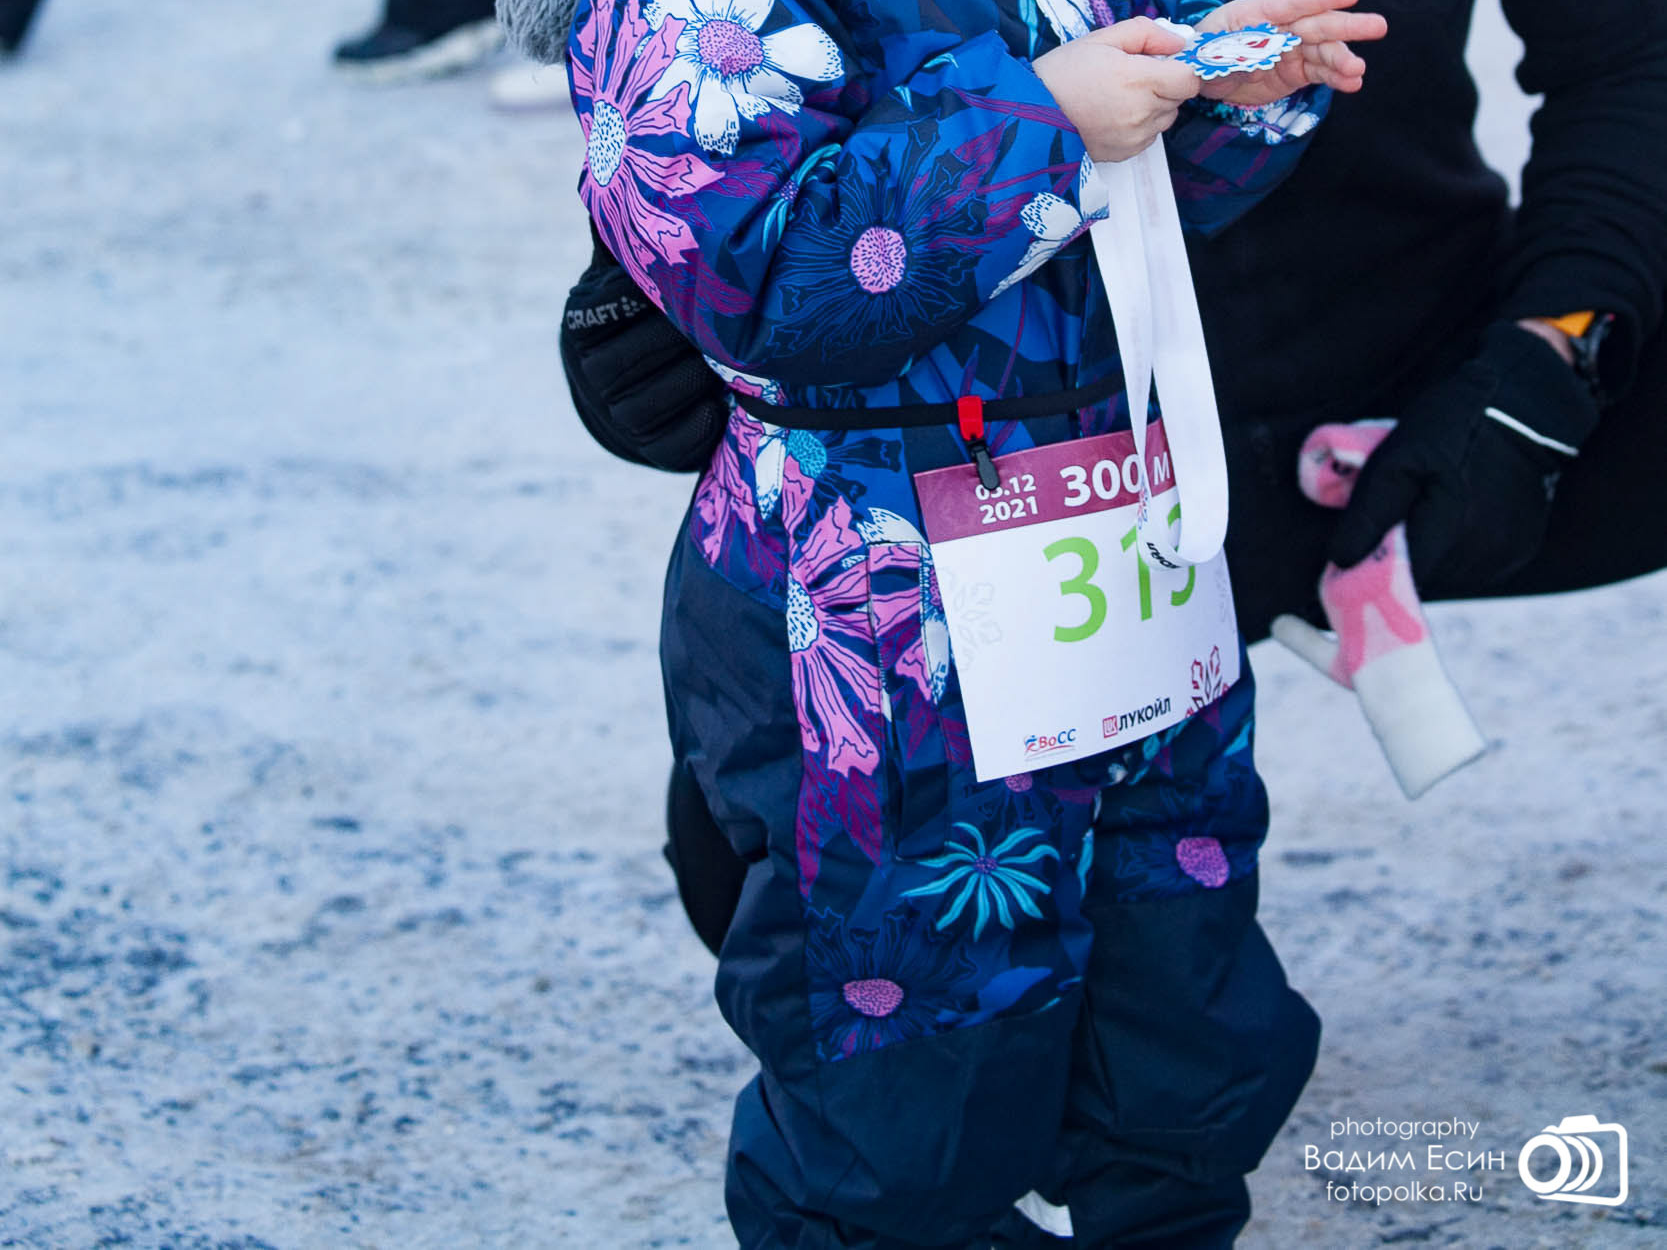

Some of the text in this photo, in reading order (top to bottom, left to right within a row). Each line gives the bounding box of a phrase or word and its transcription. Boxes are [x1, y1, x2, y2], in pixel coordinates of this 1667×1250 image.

[566, 302, 619, 330] CRAFT
[1059, 453, 1144, 508] 300
[979, 495, 1039, 525] 2021
[1118, 697, 1171, 732] ЛУКОЙЛ
